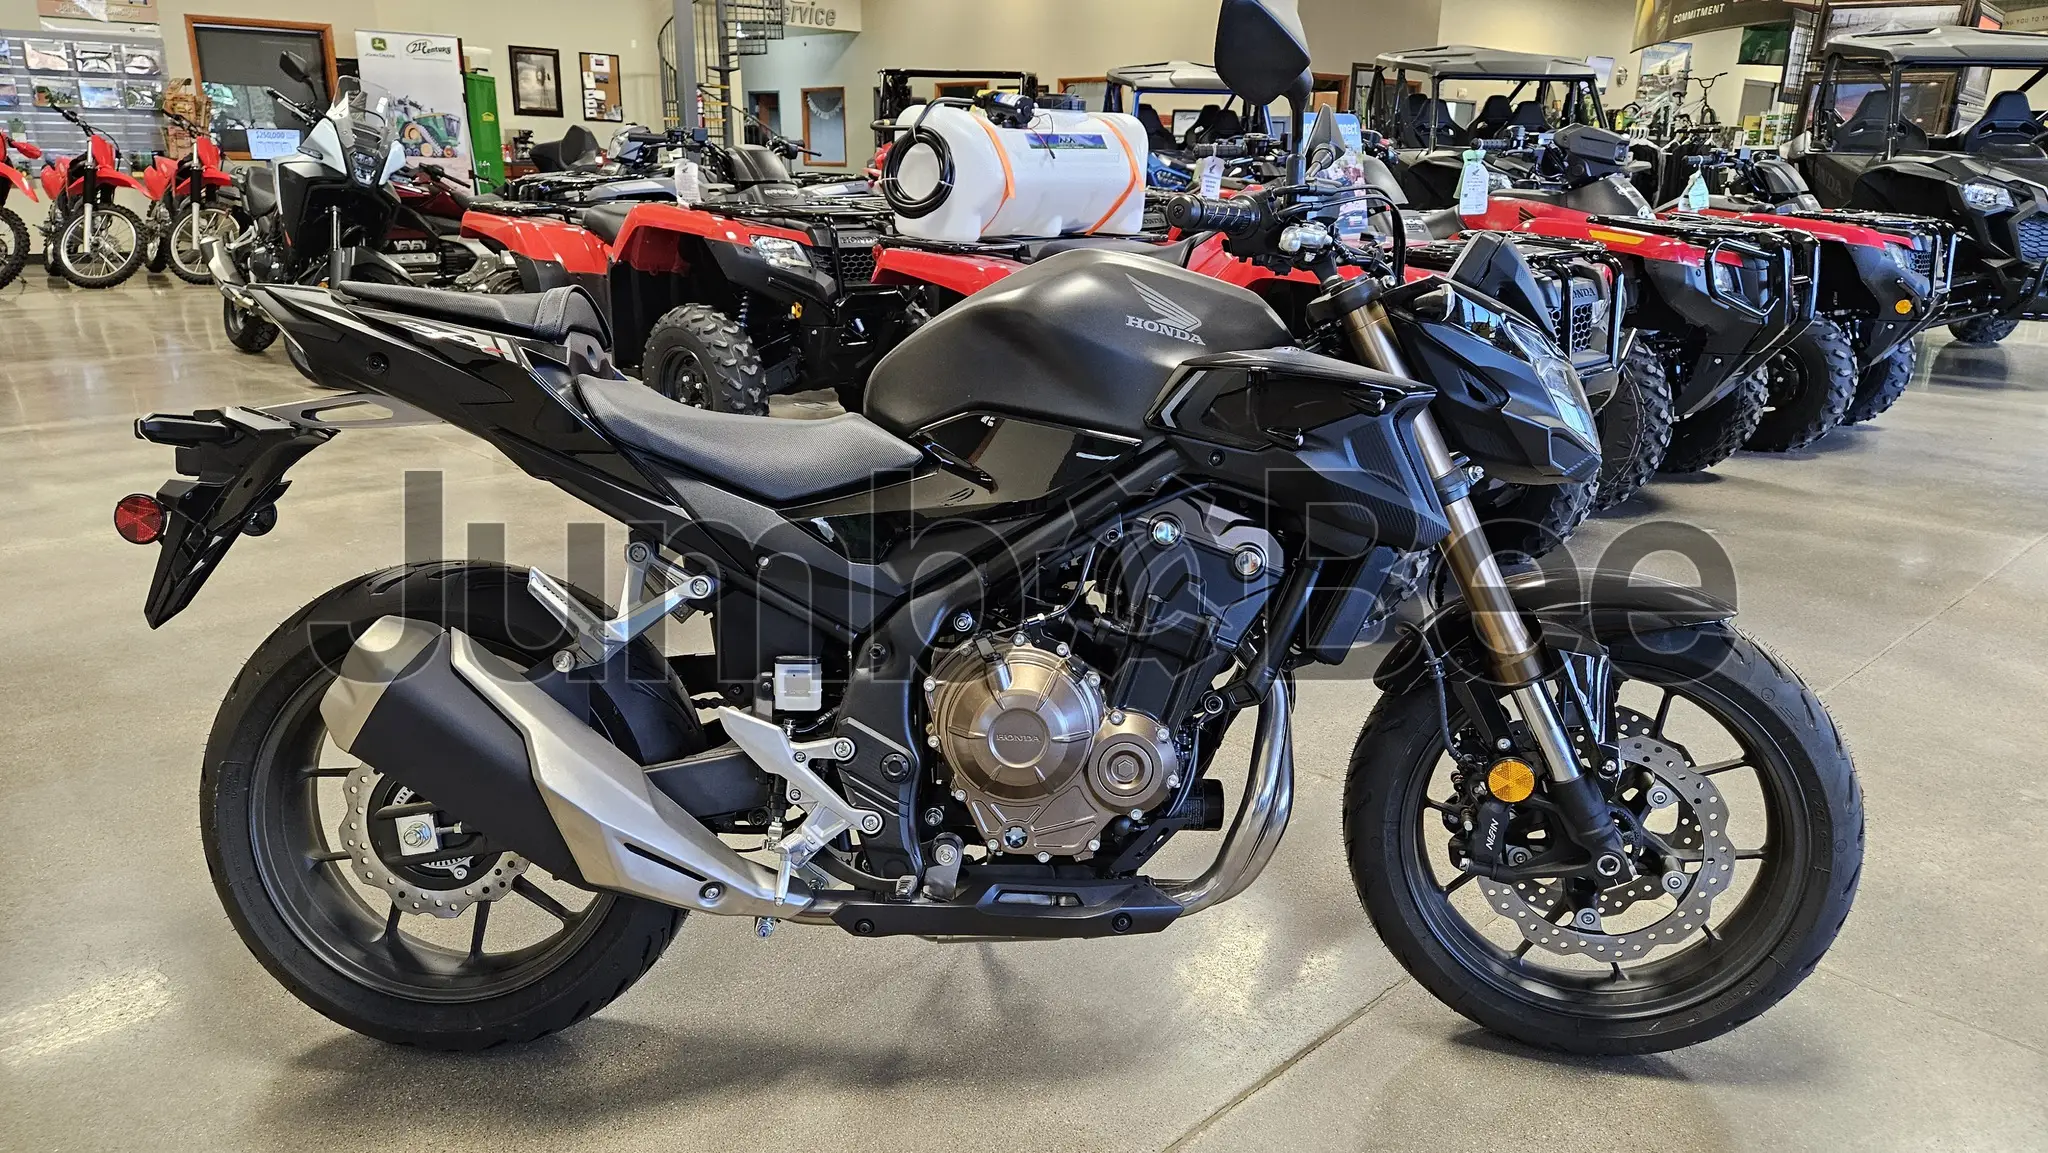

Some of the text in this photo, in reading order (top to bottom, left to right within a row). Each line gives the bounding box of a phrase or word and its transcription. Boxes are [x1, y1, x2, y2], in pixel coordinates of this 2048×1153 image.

[784, 2, 836, 27] ervice
[1673, 3, 1725, 24] COMMITMENT
[421, 45, 452, 55] Century
[1143, 217, 1166, 225] ONDA
[1572, 287, 1596, 299] ONDA
[1125, 314, 1206, 346] HONDA
[996, 733, 1041, 744] HONDA
